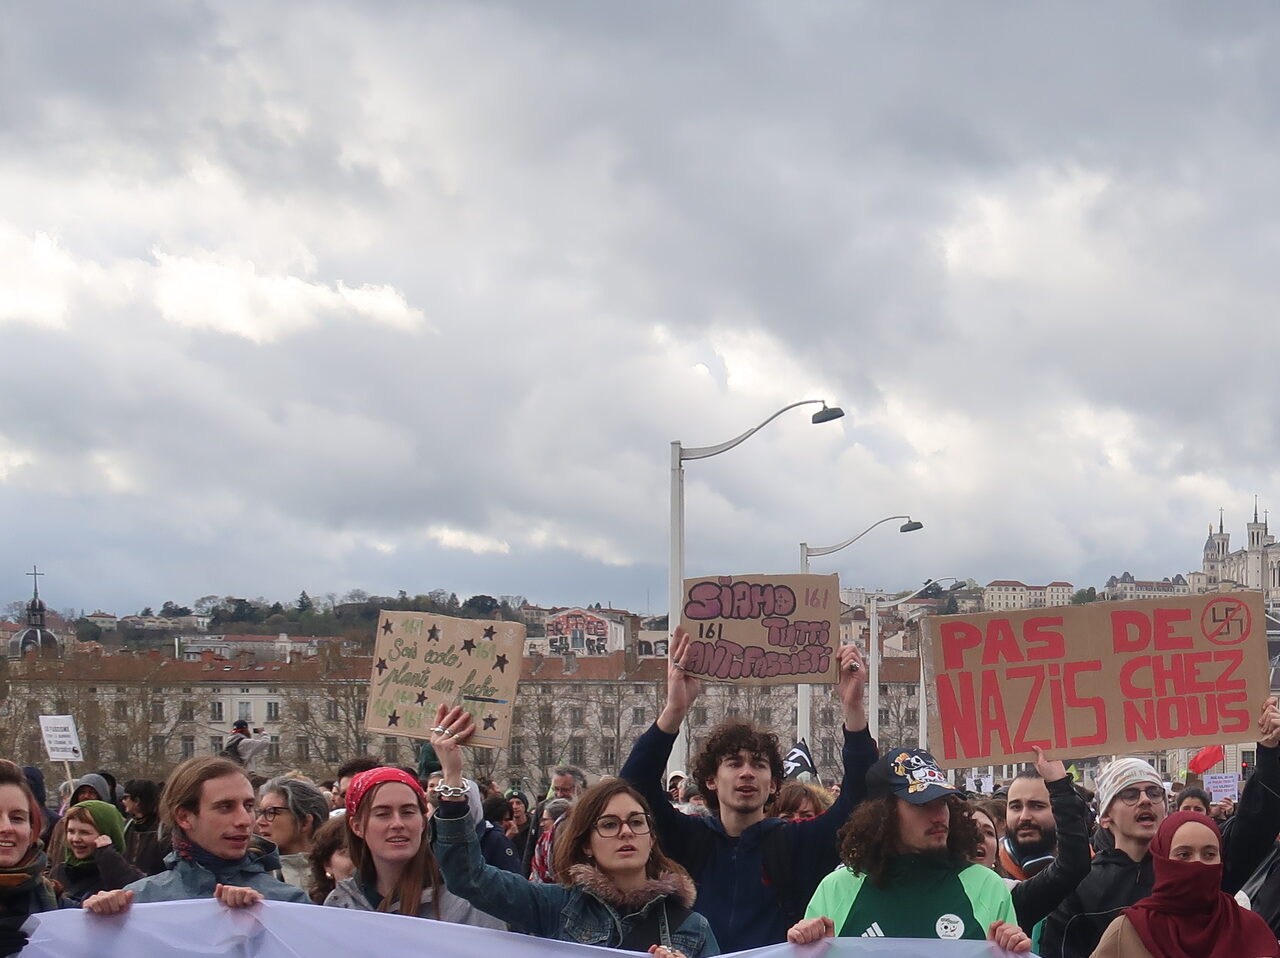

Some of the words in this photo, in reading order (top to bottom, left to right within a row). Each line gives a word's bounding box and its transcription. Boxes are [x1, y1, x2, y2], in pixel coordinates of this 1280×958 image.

[804, 587, 829, 610] 161
[698, 622, 723, 640] 161
[940, 616, 1066, 670] PAS
[1110, 607, 1194, 654] DE
[1118, 649, 1247, 699] CHEZ
[1122, 691, 1250, 742] NOUS
